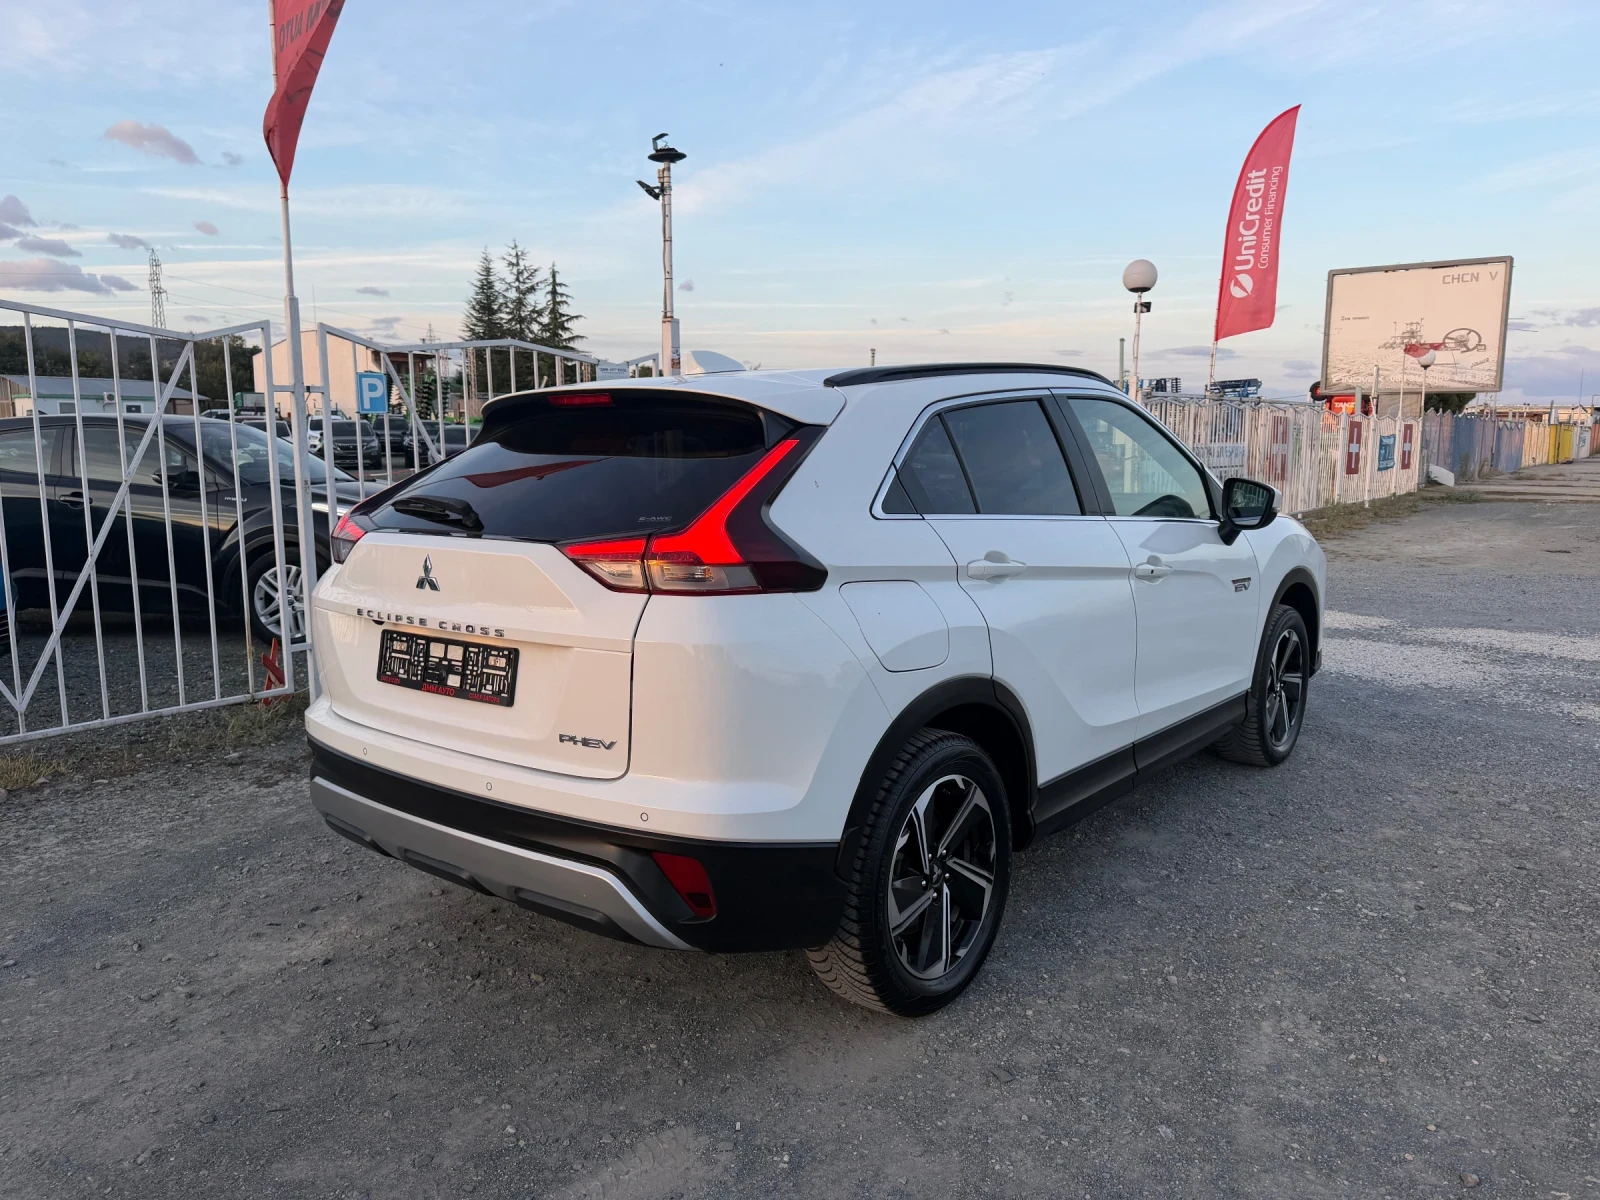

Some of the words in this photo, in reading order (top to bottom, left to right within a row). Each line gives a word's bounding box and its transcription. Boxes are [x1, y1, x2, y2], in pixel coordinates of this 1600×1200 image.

[1264, 166, 1283, 215] Financing
[1234, 168, 1267, 271] UniCredit
[1258, 218, 1273, 269] Consumer
[361, 377, 384, 410] P
[356, 608, 428, 627] ECLIPSE
[438, 620, 505, 638] CROSS
[559, 733, 618, 751] PHEV
